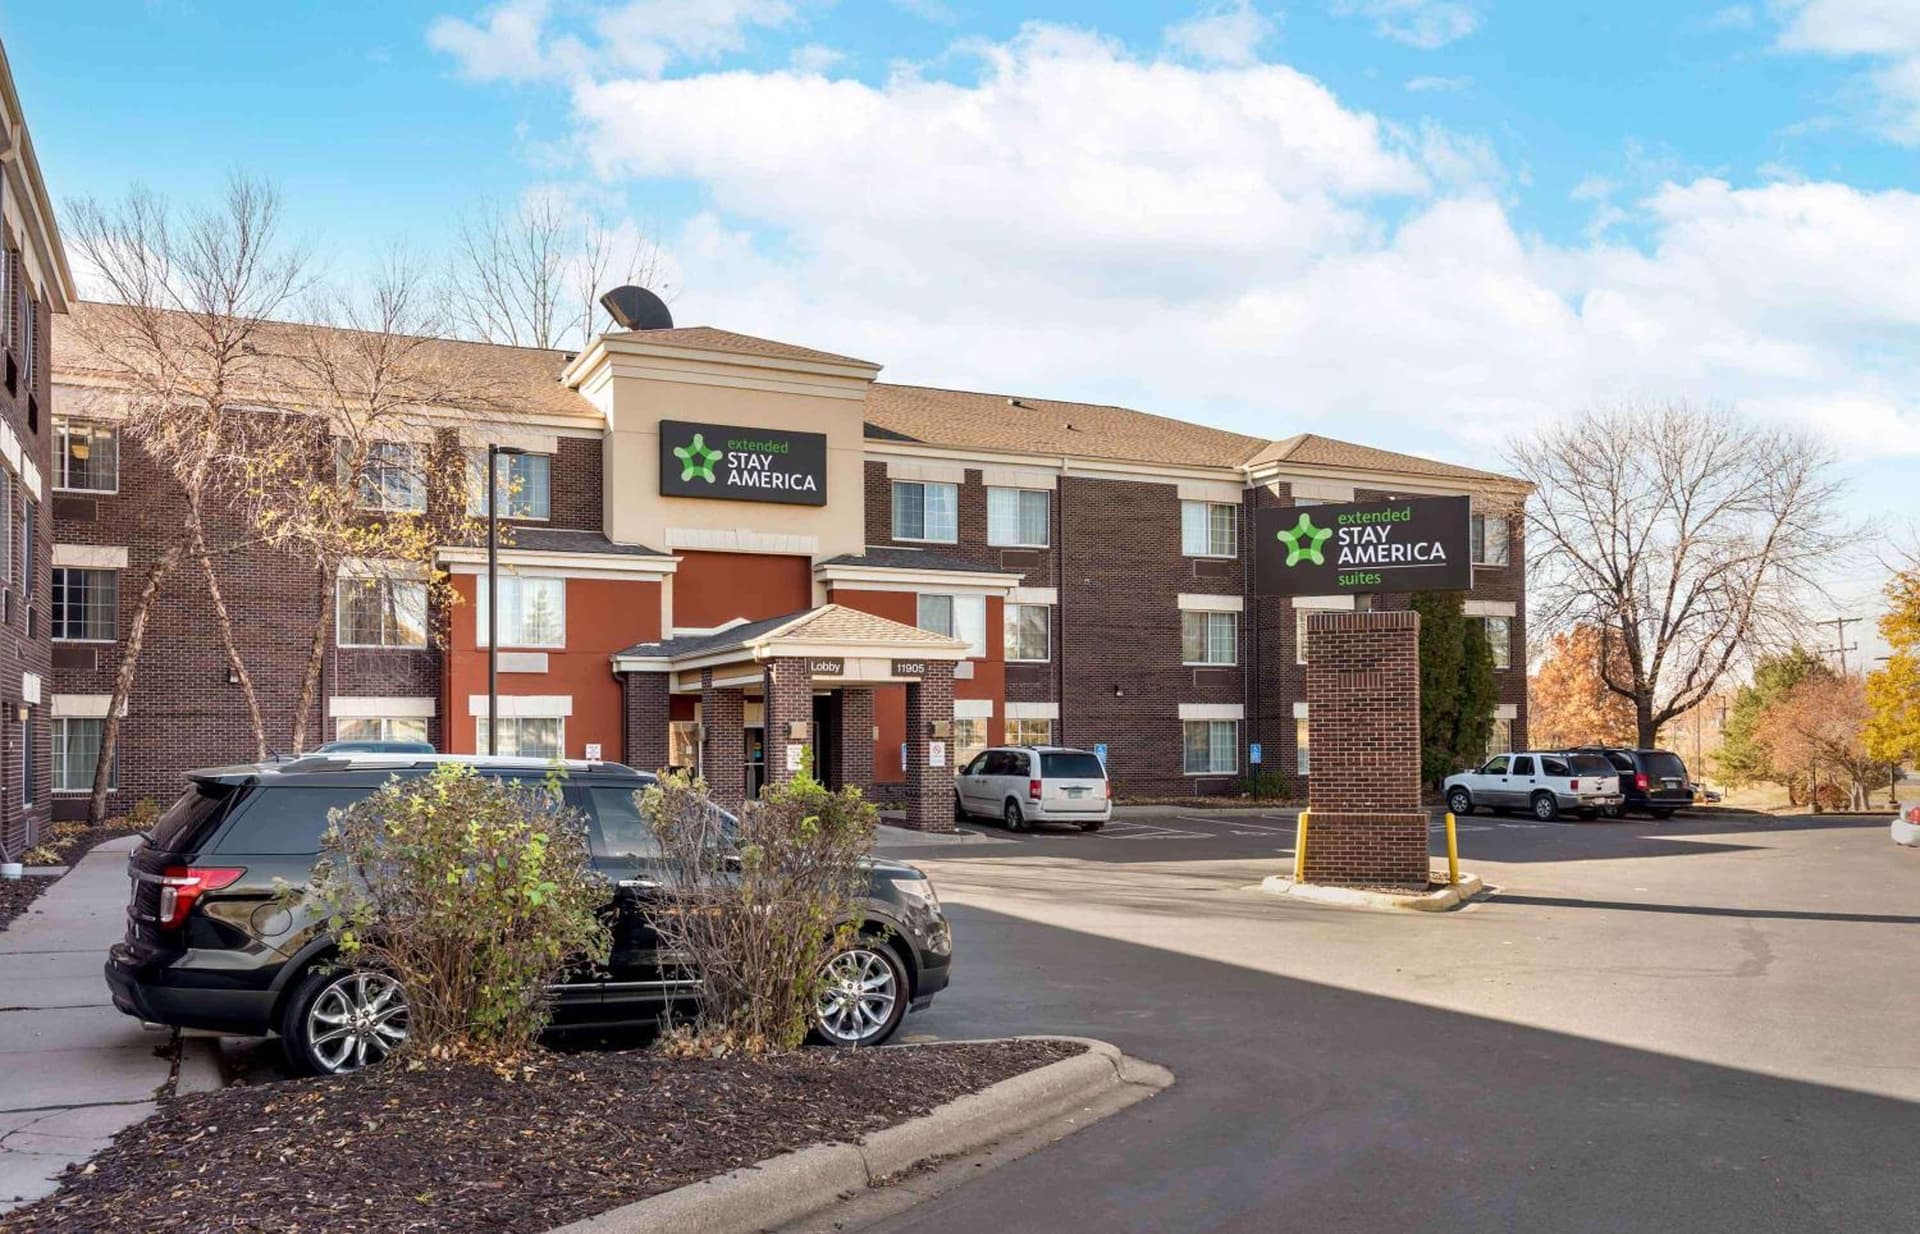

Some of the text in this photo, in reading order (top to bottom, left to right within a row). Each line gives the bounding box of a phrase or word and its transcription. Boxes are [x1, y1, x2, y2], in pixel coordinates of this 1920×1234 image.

[727, 439, 789, 454] extended
[727, 451, 773, 470] STAY
[727, 469, 817, 491] AMERICA
[1338, 507, 1411, 525] extended
[1338, 524, 1391, 546] STAY
[1338, 542, 1446, 564] AMERICA
[1338, 571, 1381, 586] suites
[810, 660, 841, 673] Lobby
[897, 663, 925, 673] 11905
